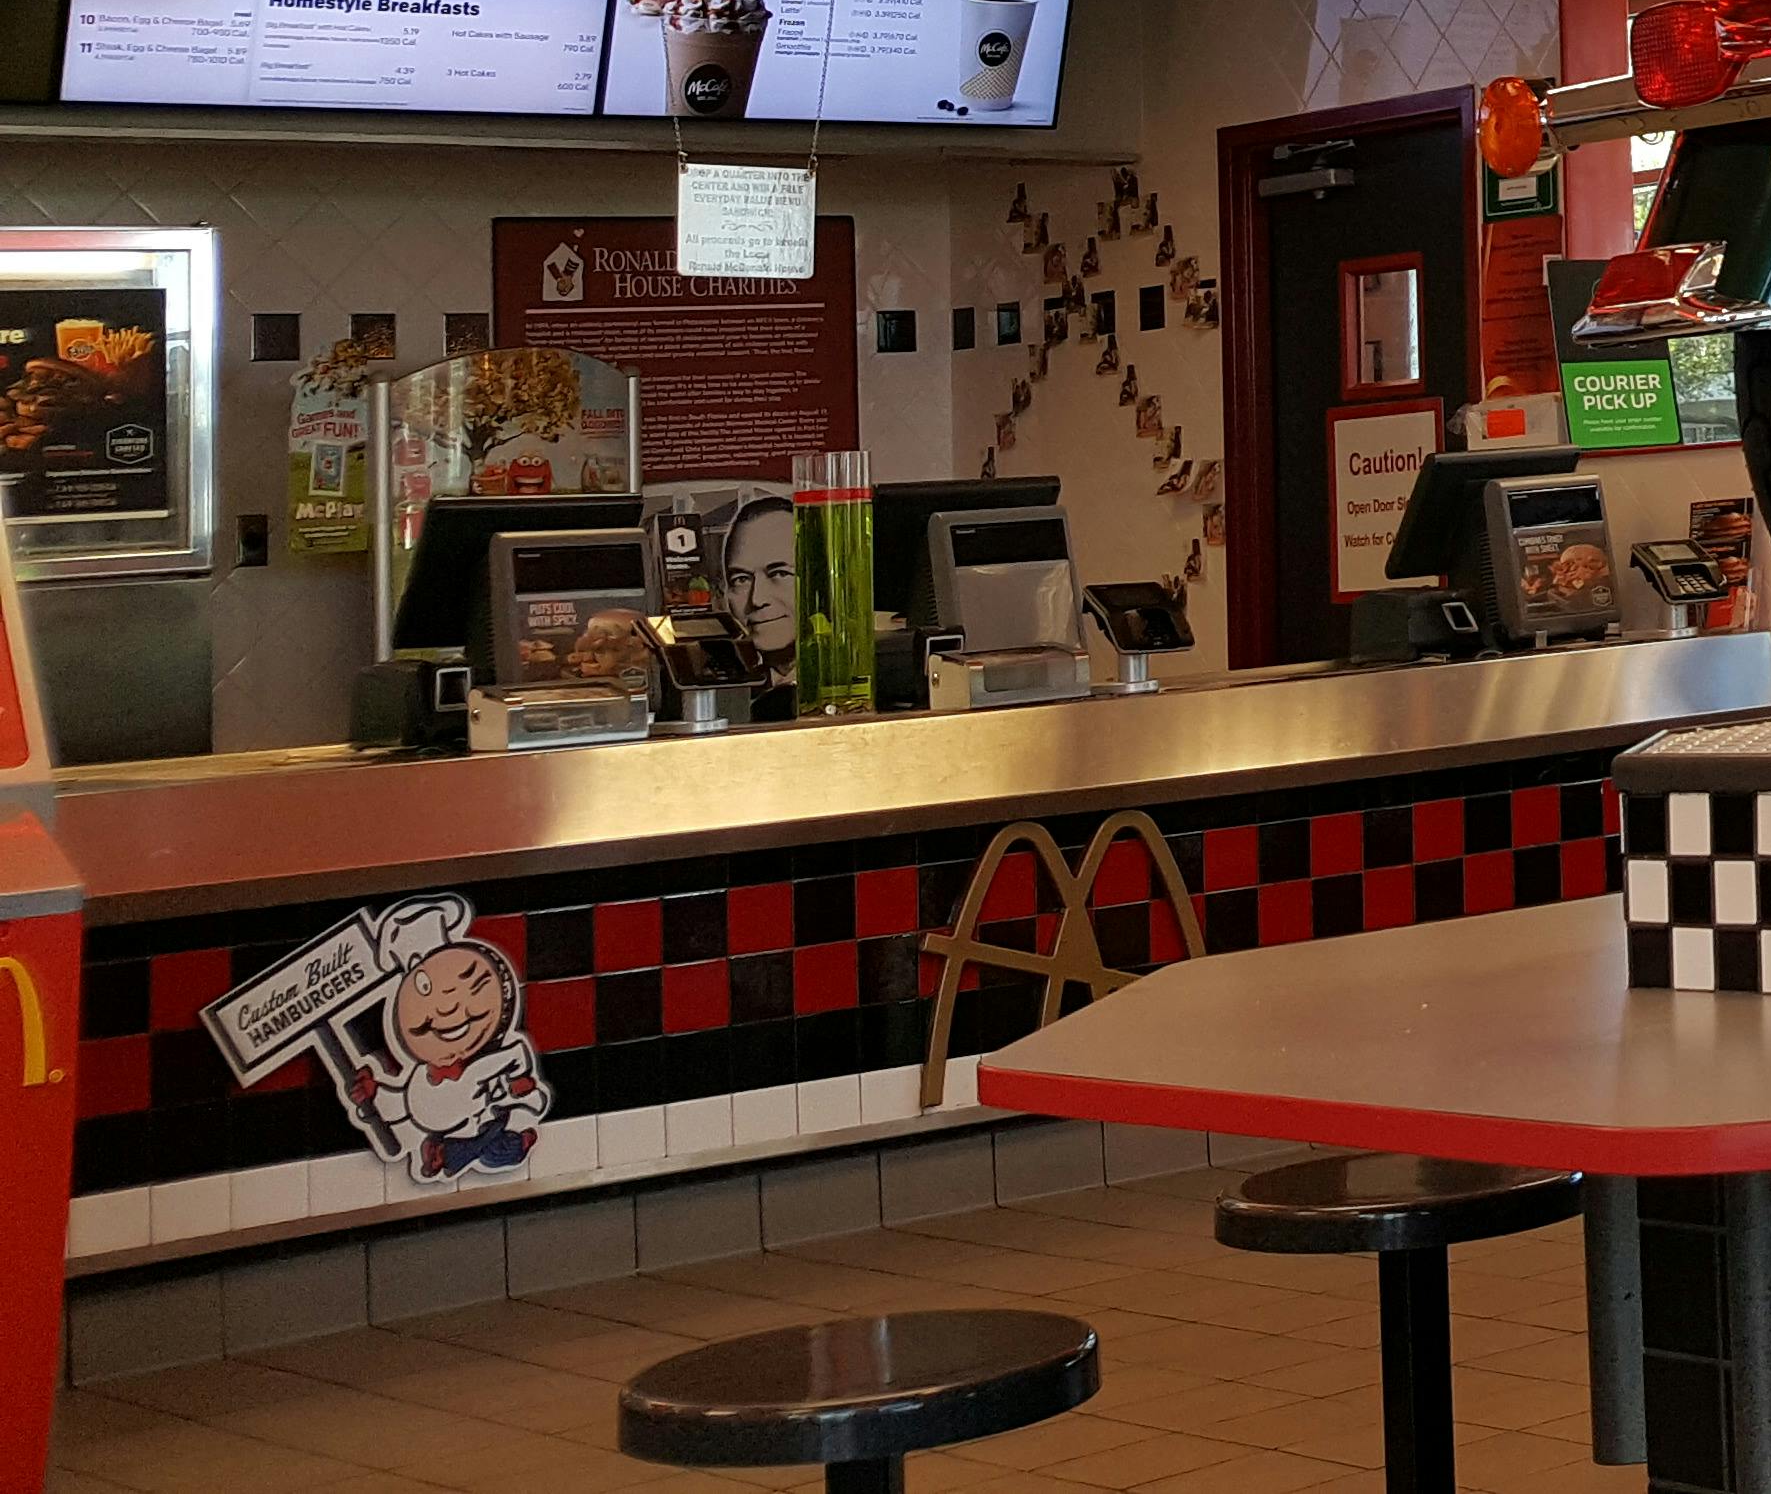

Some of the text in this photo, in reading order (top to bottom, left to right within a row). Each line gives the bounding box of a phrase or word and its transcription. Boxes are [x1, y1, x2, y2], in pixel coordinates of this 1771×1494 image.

[80, 14, 95, 25] 10
[80, 43, 93, 53] 11
[593, 247, 677, 273] RONALD
[613, 273, 798, 299] HOUSE CHARITIES
[1574, 373, 1662, 393] COURIER
[1583, 392, 1658, 411] PICK UP
[323, 421, 358, 438] FUN!
[1349, 446, 1424, 476] Caution!
[1347, 499, 1395, 517] Open Door
[1344, 533, 1384, 547] Watch for
[238, 942, 354, 1031] Custom Built
[247, 962, 366, 1048] HAMBURGERS
